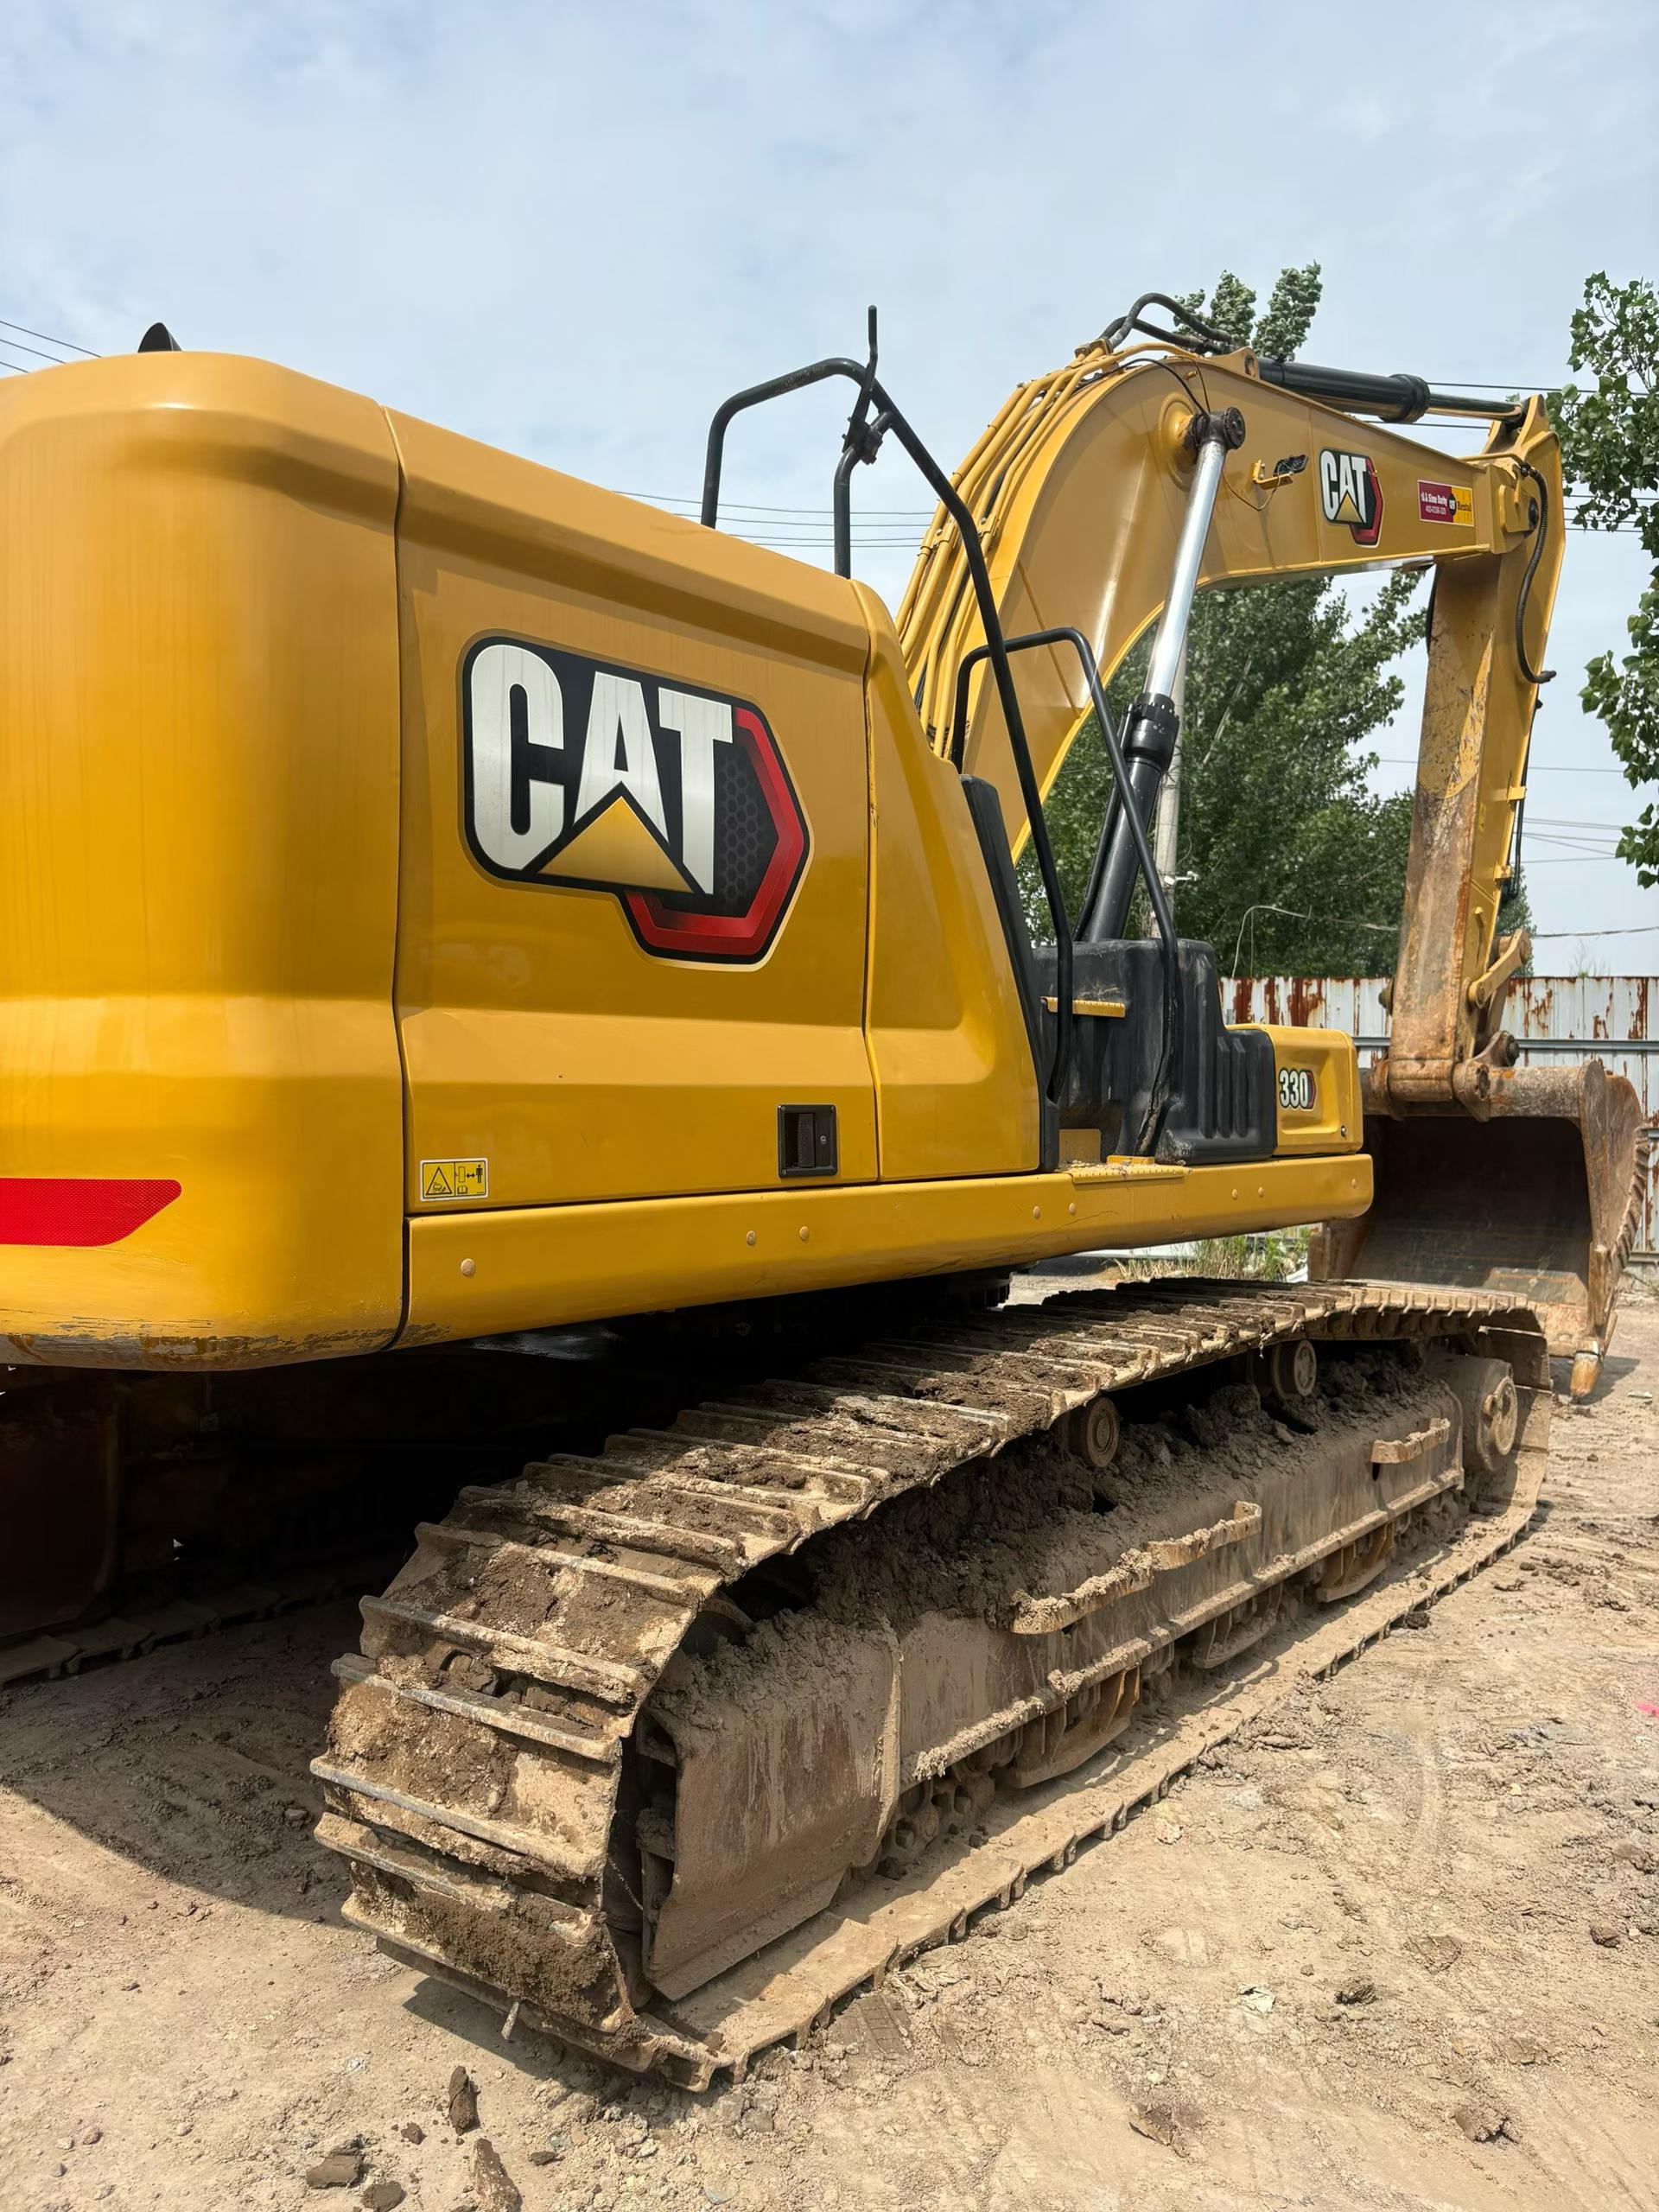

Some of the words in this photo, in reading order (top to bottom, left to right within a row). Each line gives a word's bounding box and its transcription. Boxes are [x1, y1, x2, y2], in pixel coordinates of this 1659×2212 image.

[1320, 450, 1367, 523] CAT
[471, 644, 734, 895] CAT
[1280, 1069, 1309, 1108] 330
